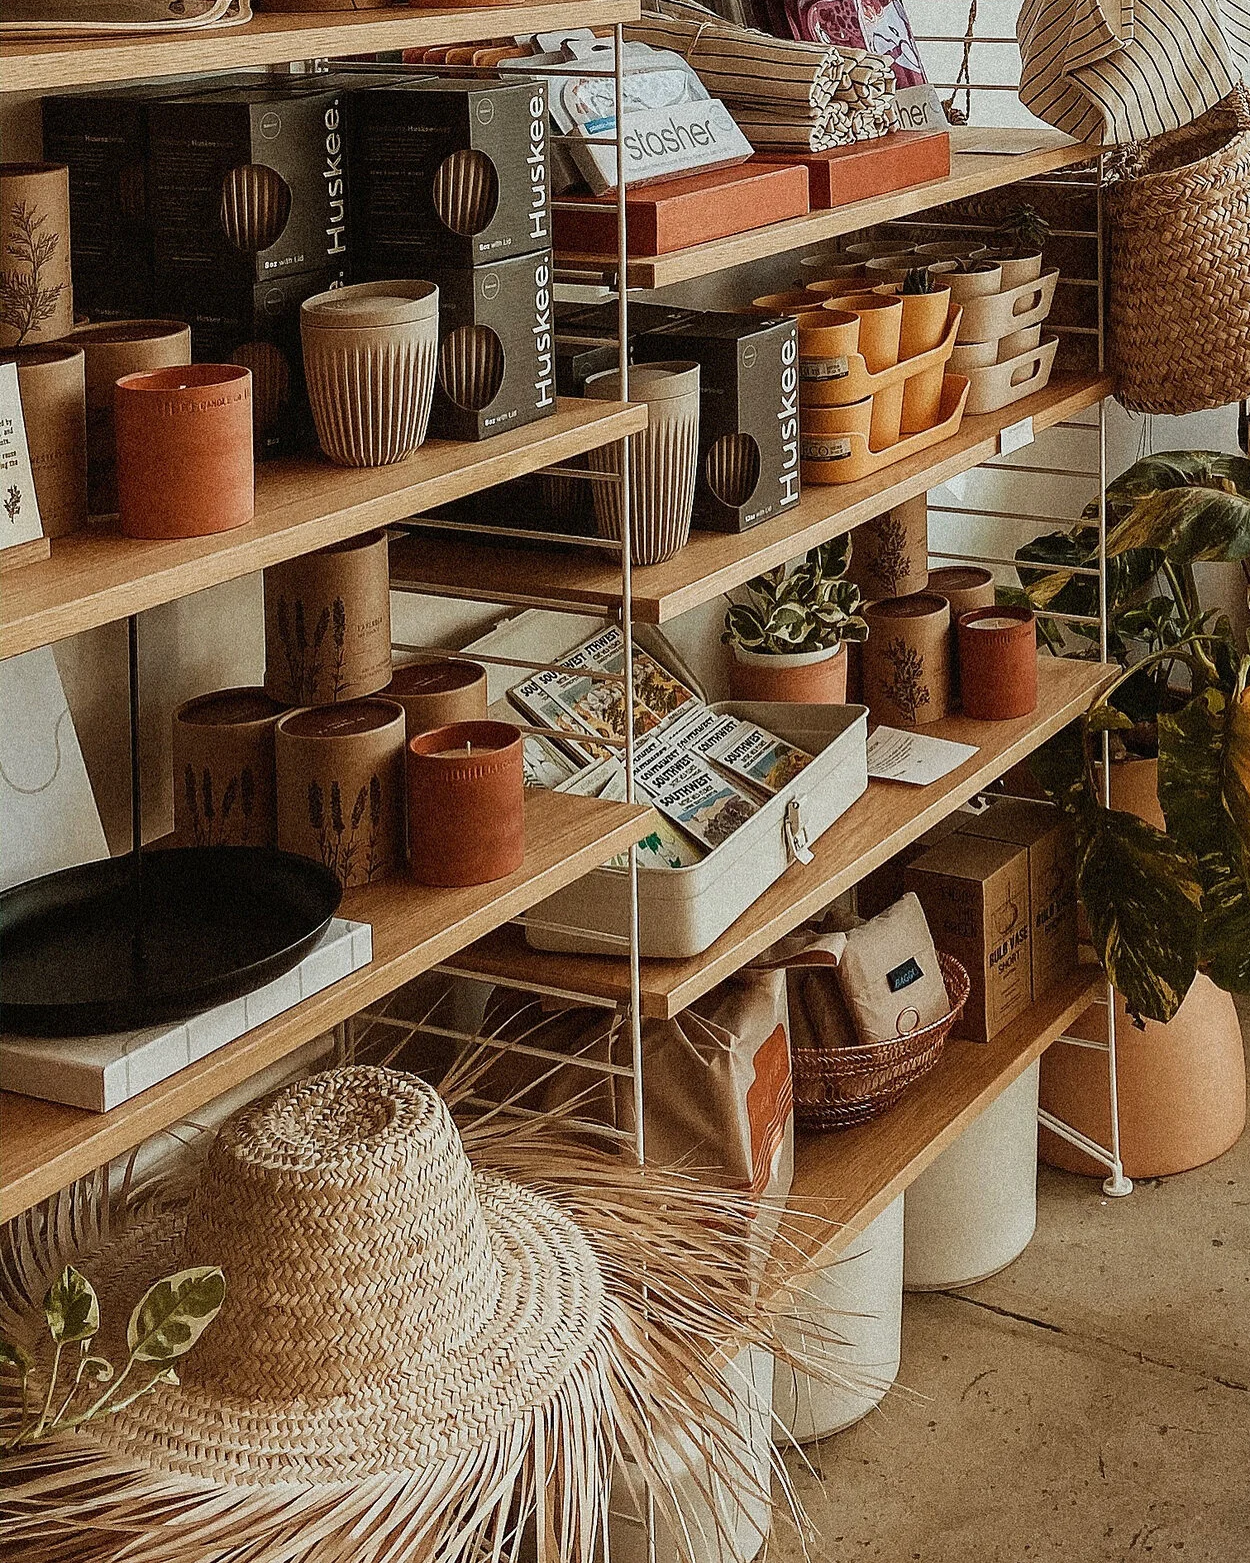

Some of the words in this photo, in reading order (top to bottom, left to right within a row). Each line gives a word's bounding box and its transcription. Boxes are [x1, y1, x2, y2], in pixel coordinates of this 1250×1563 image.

[323, 99, 346, 255] Huskee.
[526, 87, 548, 239] Huskee.
[623, 117, 717, 161] stasher
[532, 256, 553, 408] Huskee.
[777, 329, 799, 506] Huskee.
[652, 753, 695, 789] SOUTHWEST
[659, 773, 714, 807] SOUTHWEST
[723, 729, 764, 765] SOUTHWEST
